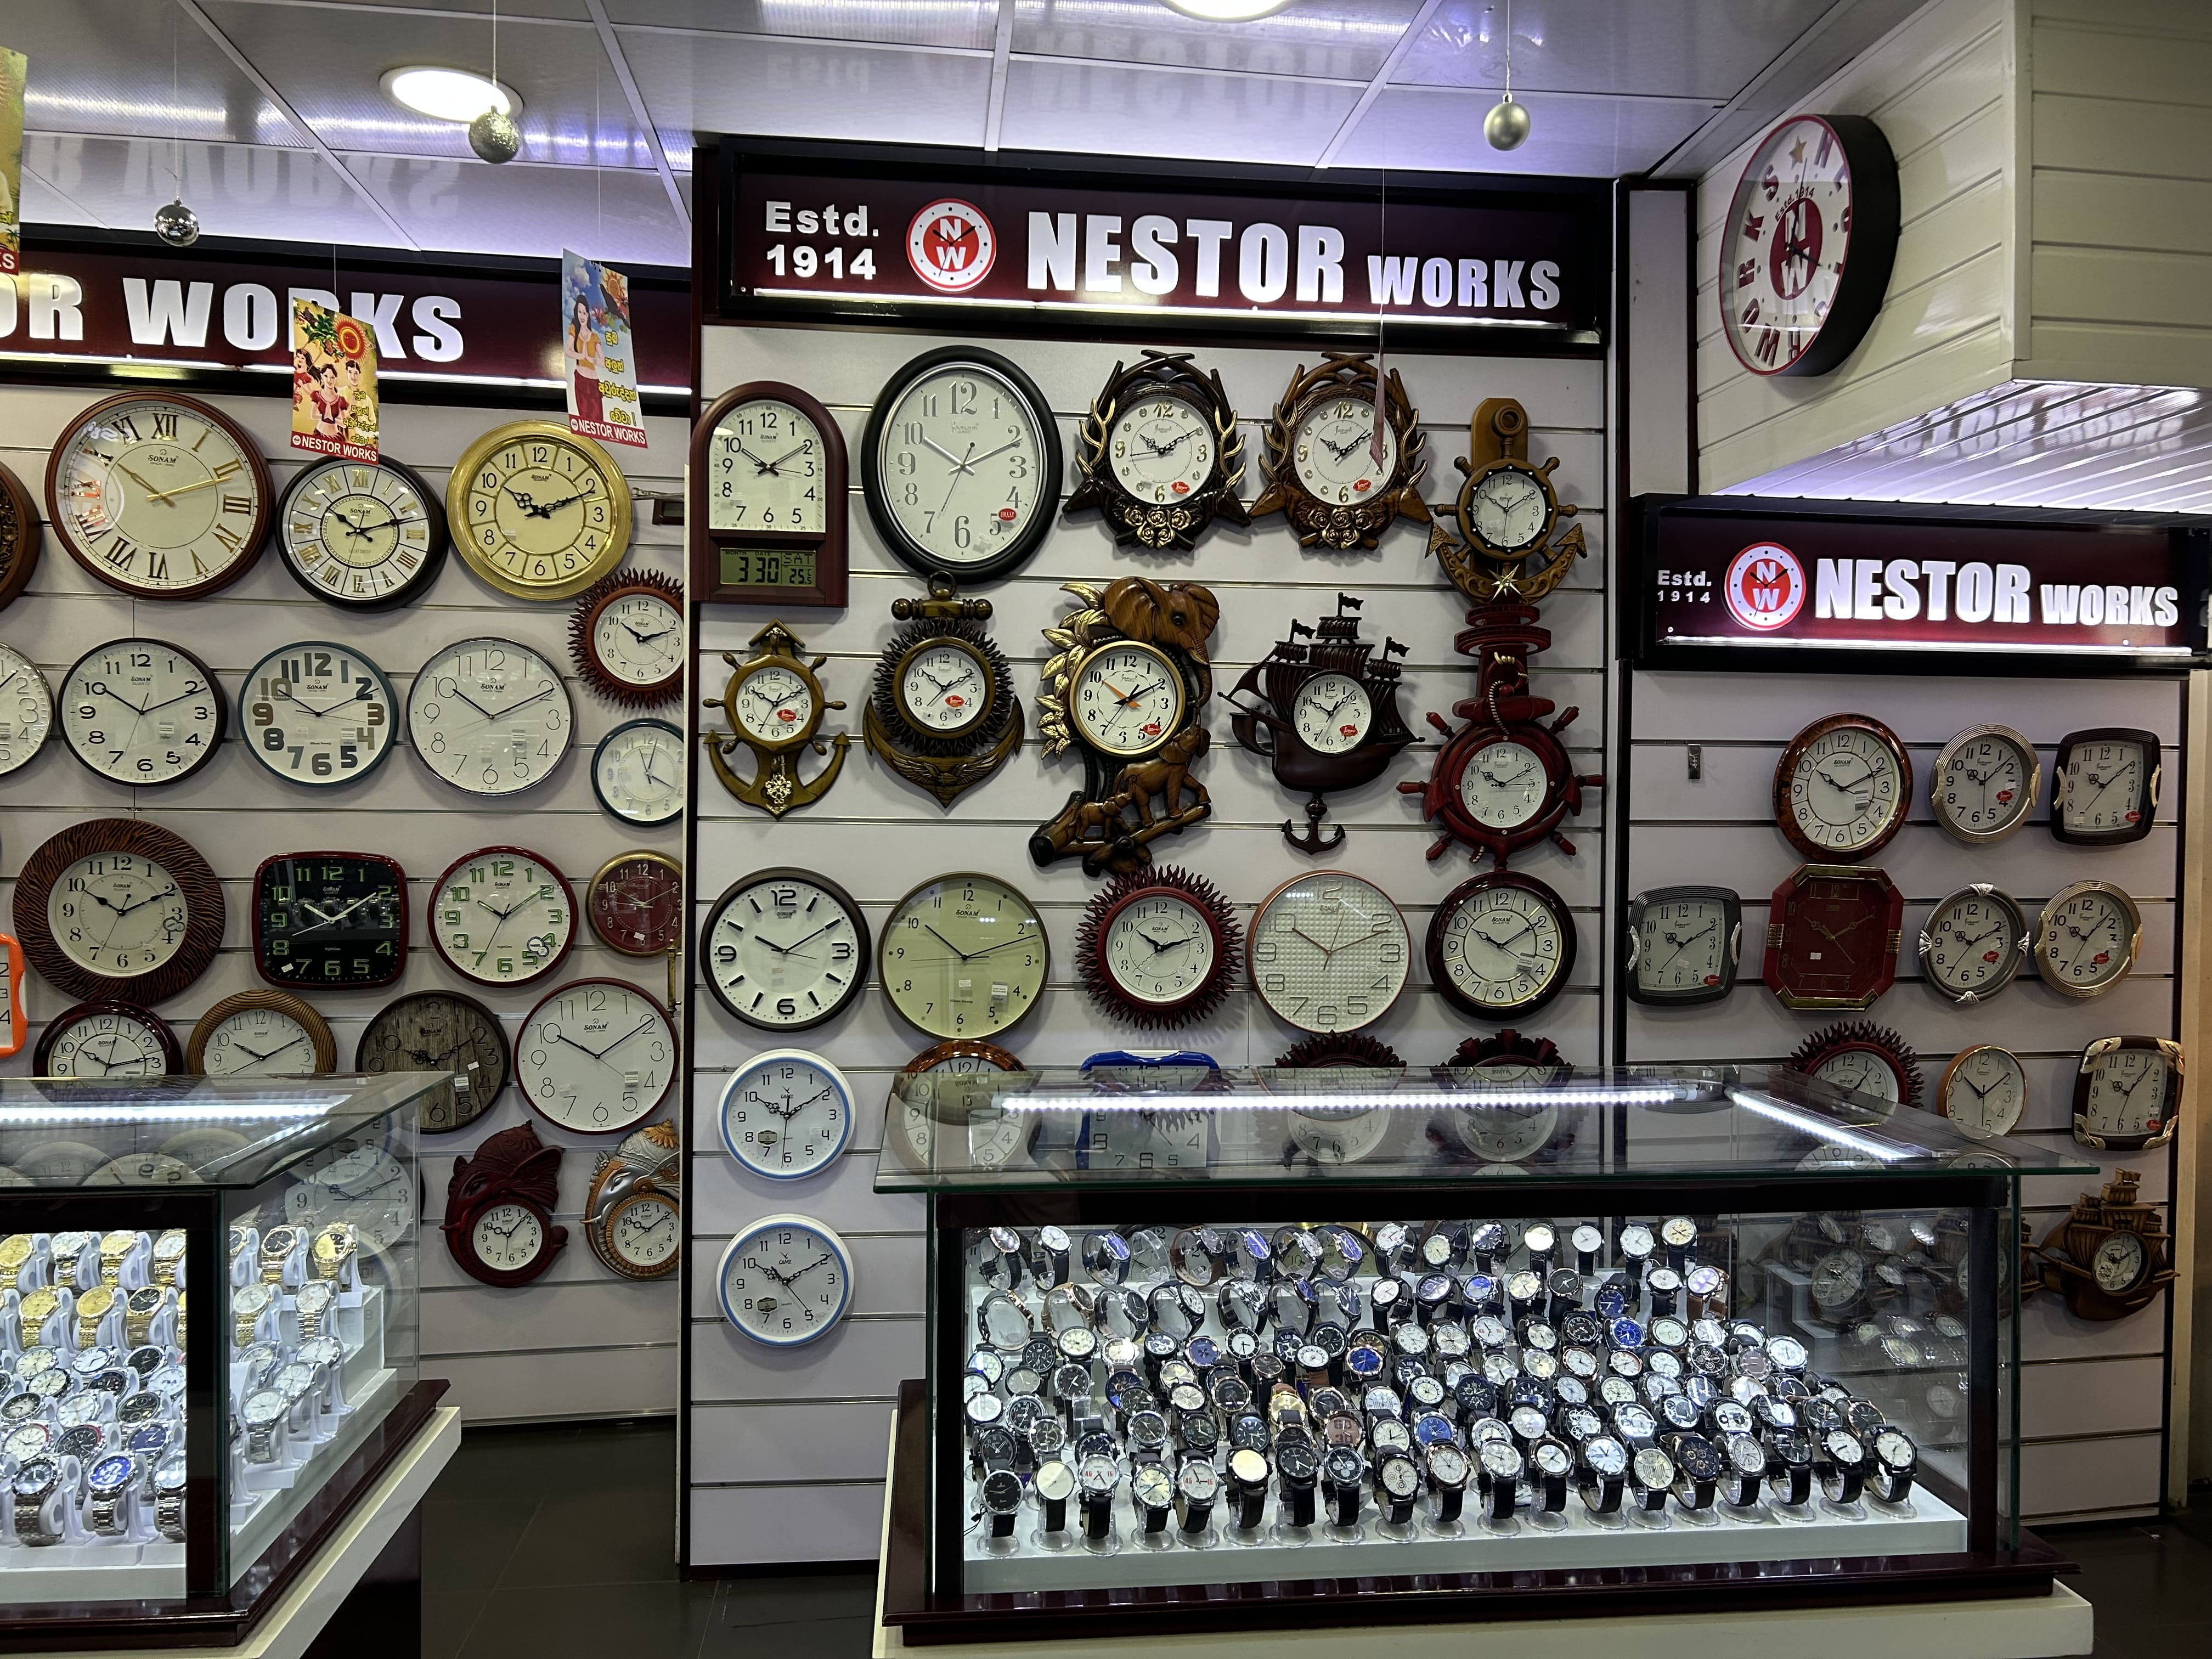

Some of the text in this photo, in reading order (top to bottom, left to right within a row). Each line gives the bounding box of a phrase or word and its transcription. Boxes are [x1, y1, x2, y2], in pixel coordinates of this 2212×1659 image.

[766, 201, 879, 237] Estd.
[766, 244, 877, 280] 1914
[1027, 211, 1560, 309] NESTOR WORKS
[949, 381, 977, 415] 12
[922, 394, 937, 417] 11
[993, 397, 999, 419] 1
[760, 413, 777, 428] 12
[579, 419, 646, 444] NESTOR WORKS
[739, 420, 753, 435] 11
[790, 421, 794, 436] 1
[904, 422, 923, 445] 10
[1007, 425, 1021, 448] 2
[302, 436, 377, 462] NESTOR WORKS
[724, 437, 741, 453] 10
[803, 439, 812, 455] 2
[148, 455, 177, 464] SONAM
[505, 453, 516, 469] 11
[533, 447, 547, 462] 12
[567, 456, 571, 471] 1
[723, 458, 733, 473] 9
[804, 461, 814, 477] 3
[898, 452, 916, 475] 9
[1009, 456, 1027, 478] 3
[482, 473, 496, 488] 10
[586, 478, 595, 494] 2
[804, 487, 815, 501] 4
[905, 483, 918, 505] 8
[1006, 487, 1022, 509] 4
[476, 501, 486, 516] 9
[593, 506, 603, 522] 3
[736, 506, 747, 521] 7
[763, 507, 774, 522] 6
[792, 509, 802, 523] 5
[924, 511, 935, 533] 7
[989, 514, 1001, 535] 5
[484, 529, 494, 545] 8
[955, 516, 970, 548] 6
[585, 535, 596, 550] 4
[506, 552, 516, 565] 7
[563, 554, 574, 569] 5
[535, 560, 545, 575] 6
[738, 557, 748, 583] 3
[755, 557, 780, 583] 30
[1657, 569, 1712, 587] Estd.
[1656, 590, 1711, 604] 1914
[1815, 557, 2179, 627] NESTOR WORKS
[131, 654, 150, 667] 12
[168, 660, 173, 673] 1
[106, 662, 120, 674] 11
[84, 682, 106, 695] 10
[184, 681, 199, 693] 2
[80, 706, 95, 719] 9
[194, 707, 207, 720] 3
[88, 731, 105, 744] 8
[185, 733, 200, 746] 4
[1838, 735, 1849, 747] 12
[1817, 742, 1825, 754] 11
[1863, 741, 1866, 753] 1
[109, 751, 124, 764] 7
[166, 751, 180, 764] 5
[137, 759, 154, 771] 6
[1799, 760, 1812, 772] 10
[1793, 785, 1802, 797] 9
[1880, 782, 1889, 793] 3
[1798, 808, 1808, 820] 8
[1874, 805, 1883, 817] 4
[1815, 825, 1824, 838] 7
[1857, 823, 1866, 834] 5
[1836, 830, 1844, 842] 6
[771, 889, 797, 906] 12
[963, 890, 974, 901] 12
[1495, 893, 1508, 905] 12
[934, 897, 941, 908] 11
[998, 900, 1001, 911] 1
[1473, 900, 1482, 912] 11
[1523, 899, 1526, 911] 1
[909, 918, 918, 929] 10
[1018, 923, 1025, 934] 2
[1454, 917, 1467, 929] 10
[832, 943, 850, 959] 3
[1448, 941, 1458, 953] 9
[1542, 939, 1553, 951] 3
[718, 945, 736, 962] 9
[897, 948, 904, 958] 9
[1025, 955, 1031, 966] 3
[1454, 964, 1464, 976] 8
[1535, 963, 1545, 975] 4
[904, 980, 911, 991] 8
[1013, 986, 1020, 996] 4
[1472, 981, 1481, 994] 7
[1494, 986, 1504, 998] 6
[1517, 980, 1528, 992] 5
[777, 998, 795, 1015] 6
[926, 1003, 933, 1014] 7
[988, 1007, 995, 1018] 5
[957, 1013, 963, 1024] 6
